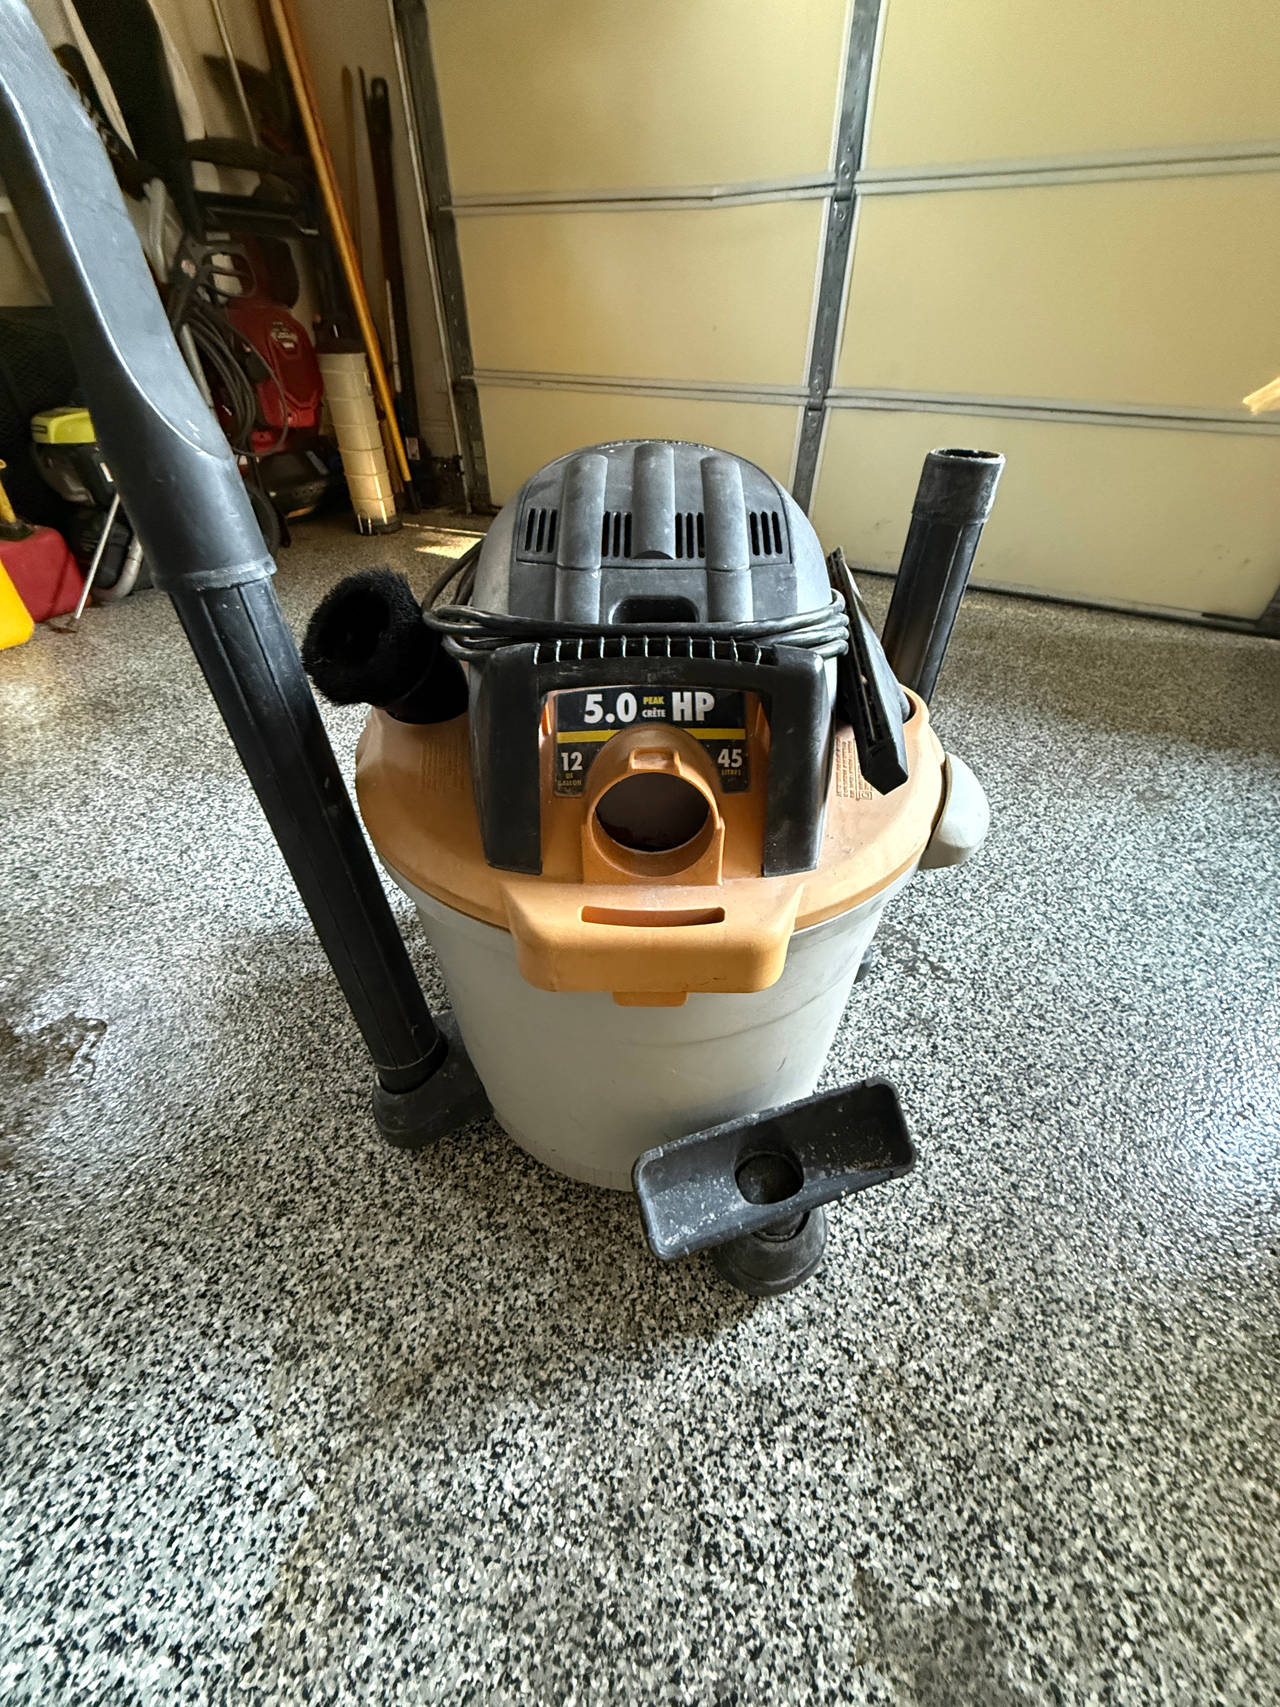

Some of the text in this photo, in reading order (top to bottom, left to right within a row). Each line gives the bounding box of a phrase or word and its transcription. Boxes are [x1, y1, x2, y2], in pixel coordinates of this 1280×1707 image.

[584, 692, 715, 723] 5.0 HP
[643, 695, 664, 705] PEAK
[641, 707, 666, 718] CRÊTE
[561, 751, 583, 771] 12
[718, 748, 743, 768] 45
